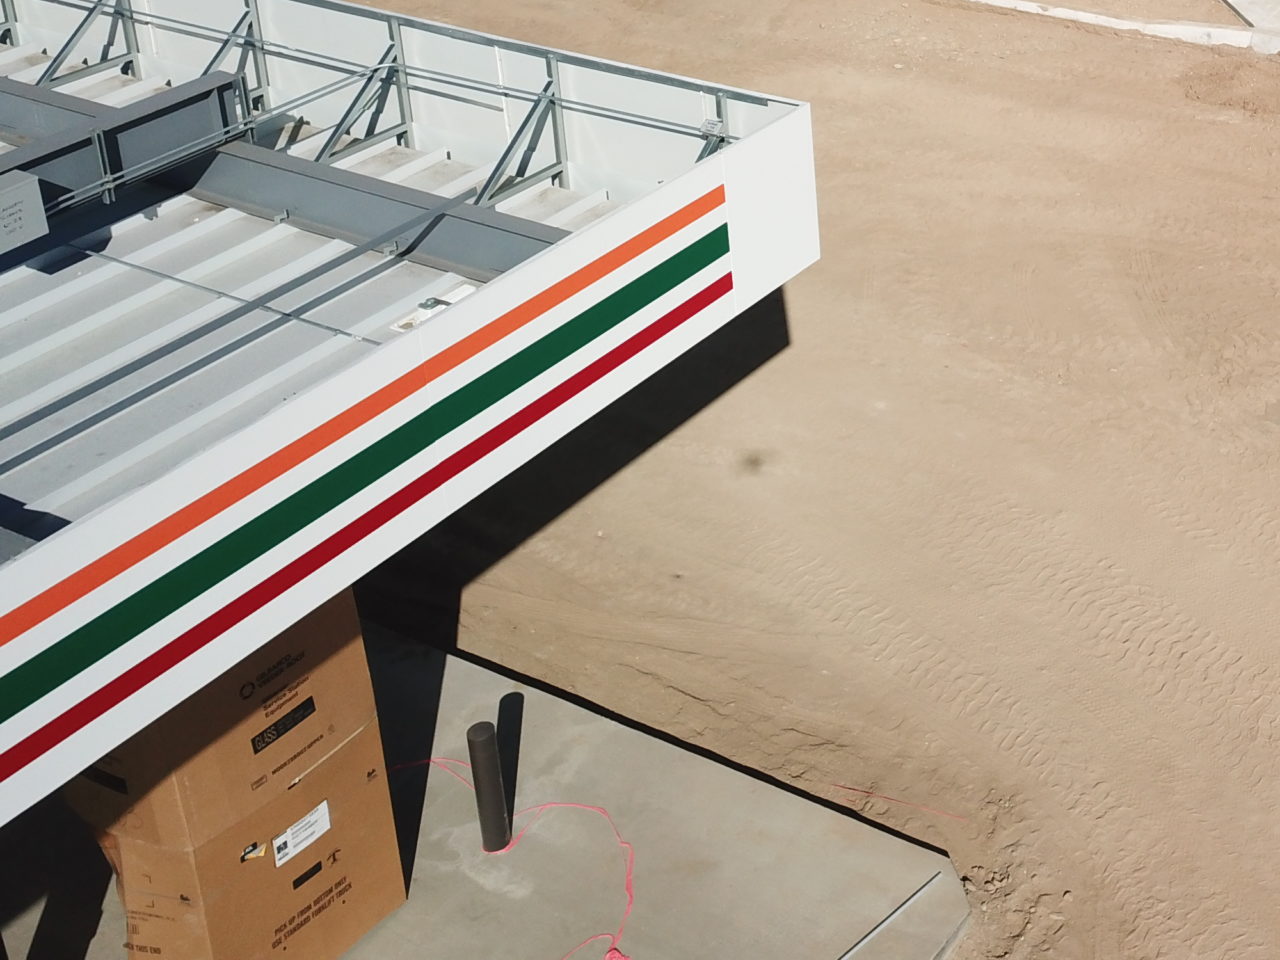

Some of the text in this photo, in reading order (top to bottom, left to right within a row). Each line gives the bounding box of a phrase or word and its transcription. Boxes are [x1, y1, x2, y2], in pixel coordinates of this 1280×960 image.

[254, 726, 278, 750] GLASS
[274, 875, 347, 937] PICK UP FROM BOTTOM ONLY
[283, 916, 311, 941] STANDARD
[311, 895, 335, 920] FORKLIFT
[335, 881, 353, 900] TRUCK
[135, 944, 149, 953] THIS
[149, 946, 161, 955] END
